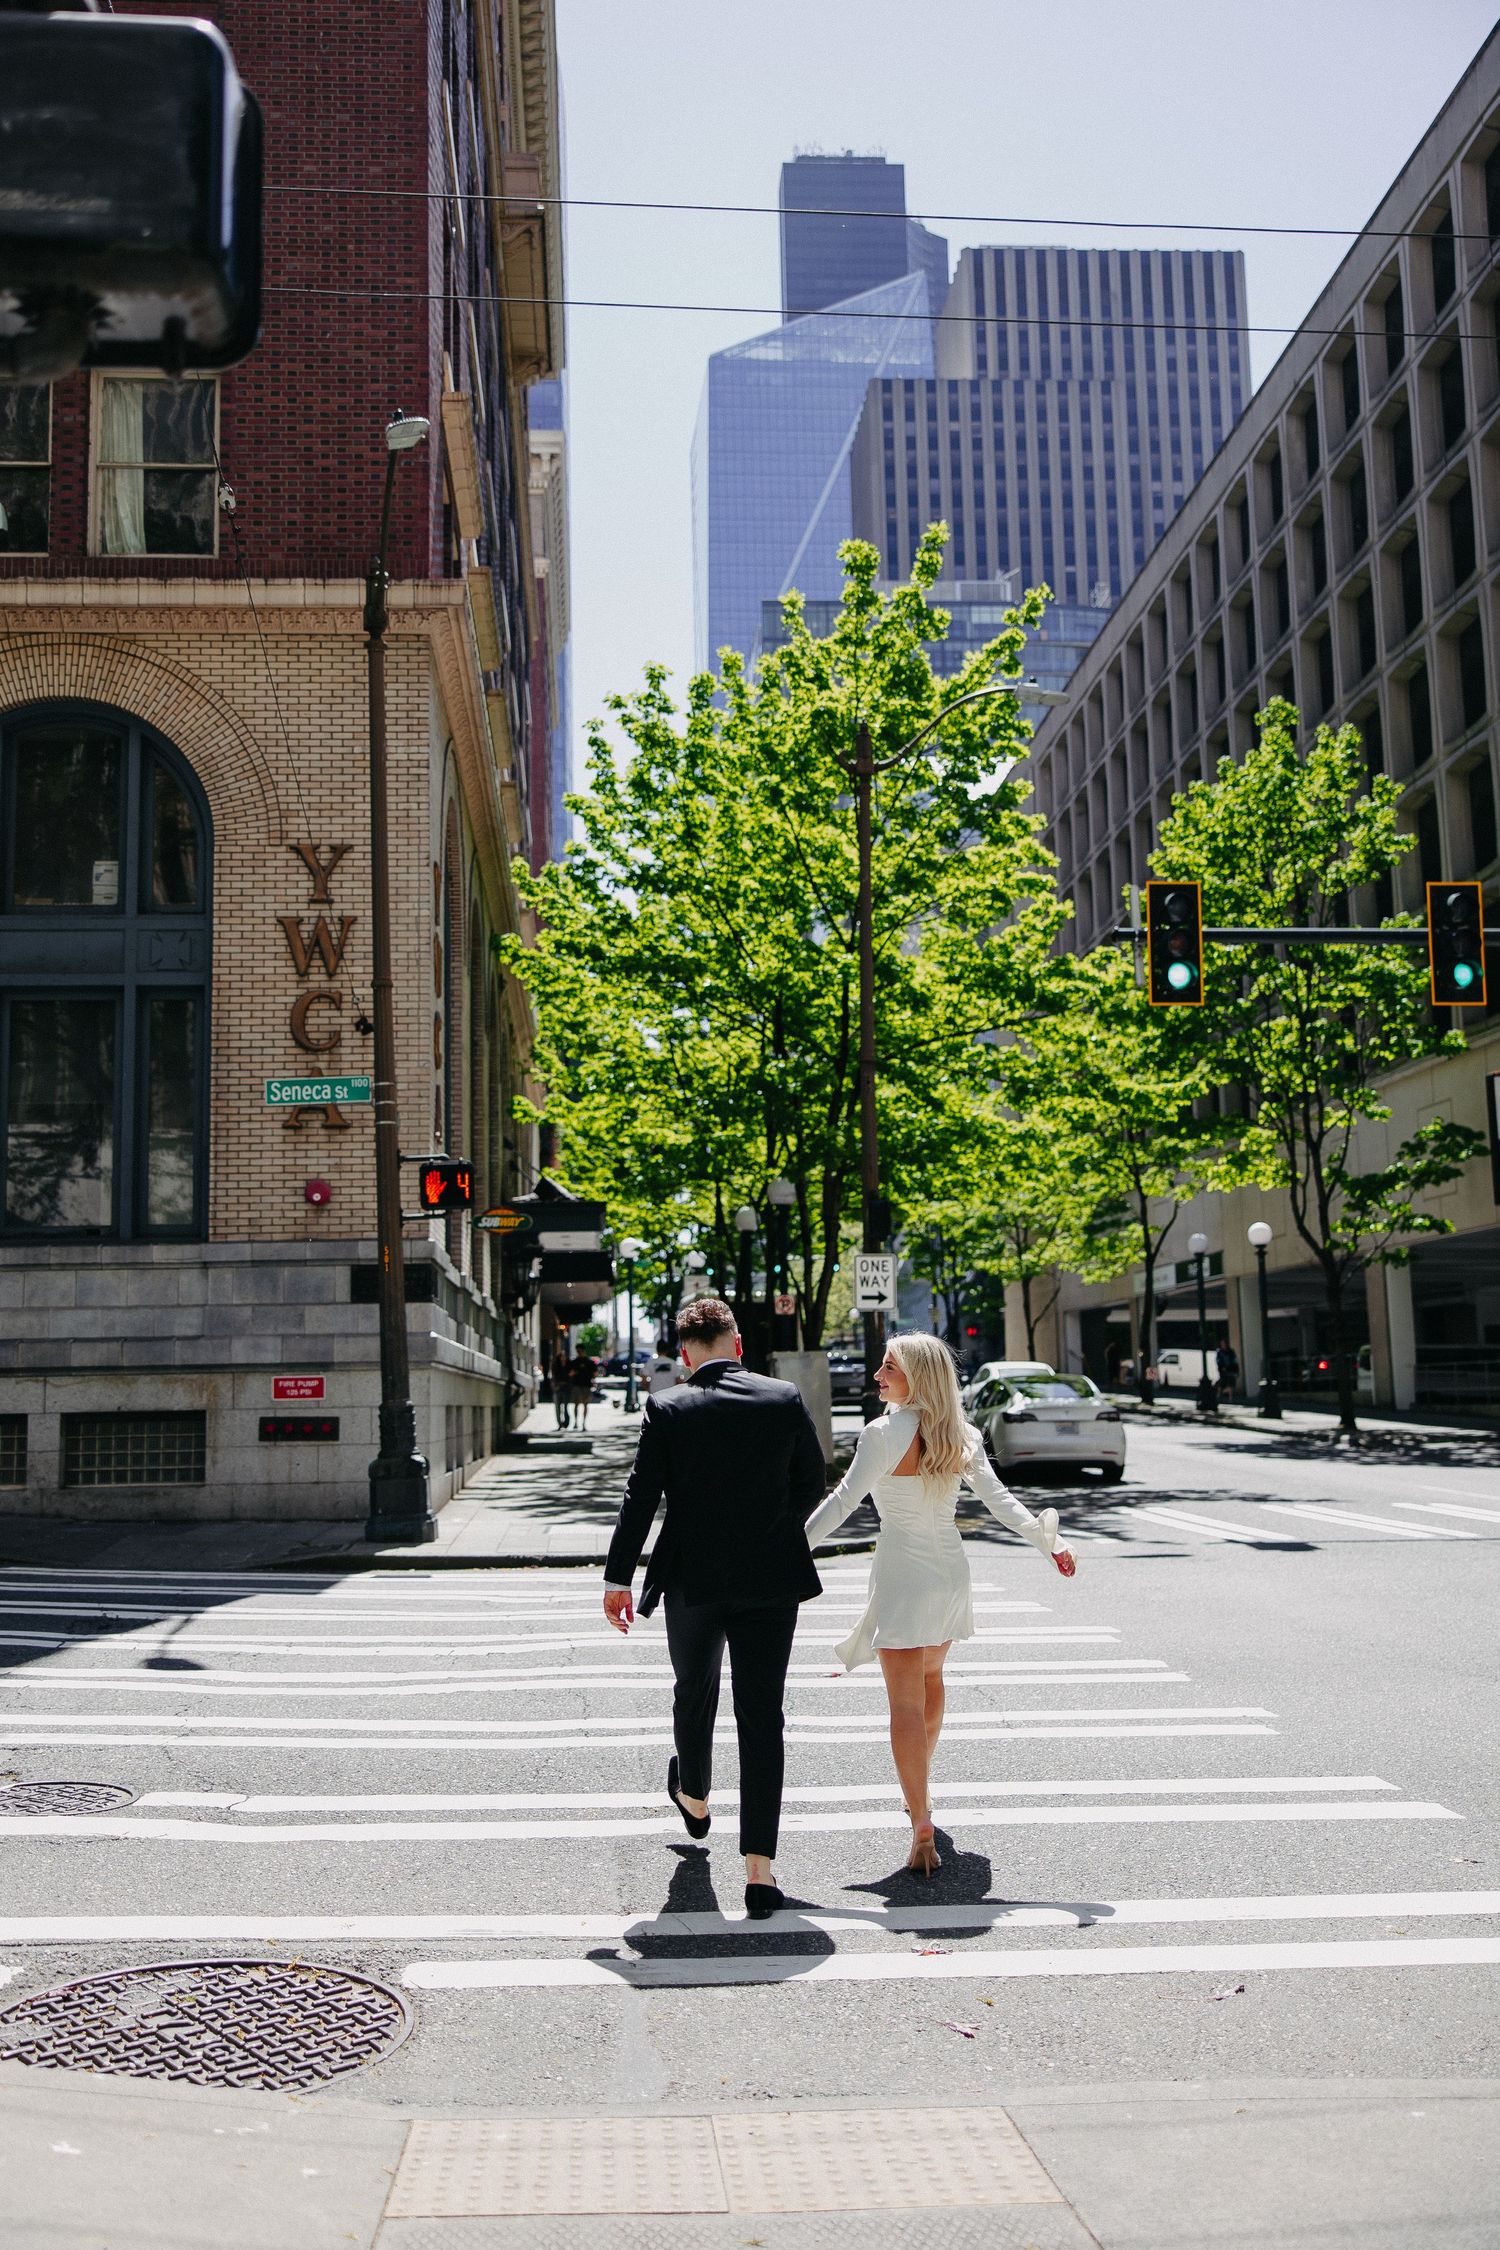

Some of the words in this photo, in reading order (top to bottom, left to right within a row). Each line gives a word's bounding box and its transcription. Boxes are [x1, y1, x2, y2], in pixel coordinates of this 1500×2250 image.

[277, 843, 357, 1129] YWCA
[351, 1078, 368, 1088] 1100
[270, 1082, 331, 1101] Seneca
[335, 1085, 349, 1099] St
[457, 1171, 470, 1199] 4
[478, 1216, 525, 1228] SUBWAY
[860, 1260, 889, 1272] ONE
[859, 1275, 890, 1287] WAY
